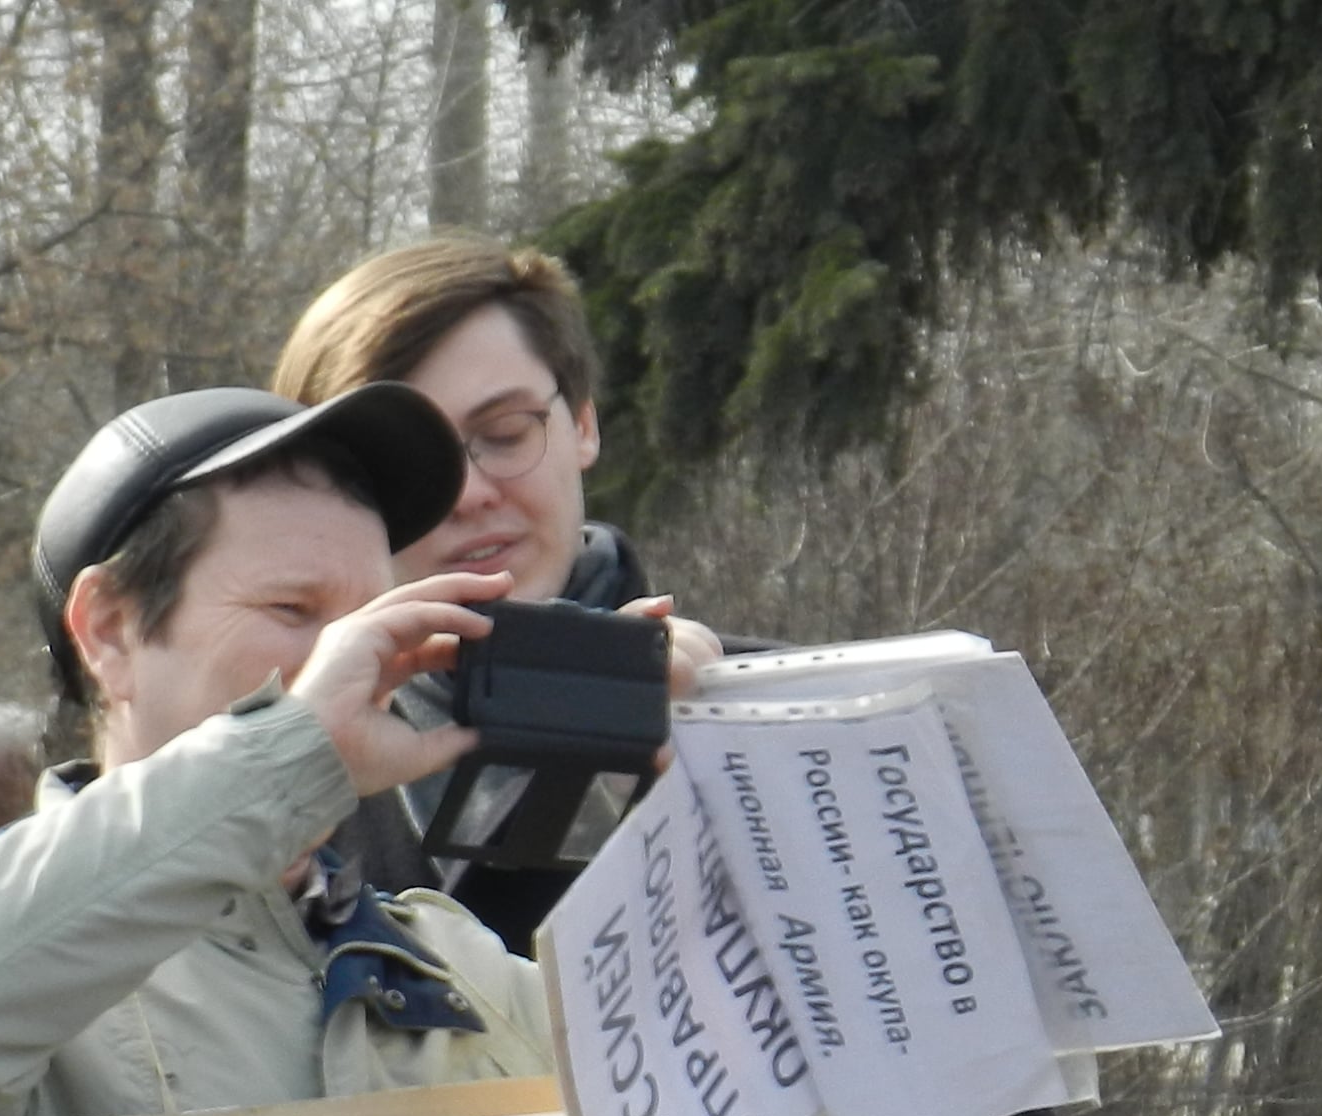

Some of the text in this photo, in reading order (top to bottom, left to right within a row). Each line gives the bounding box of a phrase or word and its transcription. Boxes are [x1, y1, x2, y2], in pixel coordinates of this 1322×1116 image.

[723, 751, 846, 1058] ционная Армия.
[841, 884, 879, 940] как
[863, 949, 912, 1055] окупа-
[870, 744, 977, 1016] Государство в
